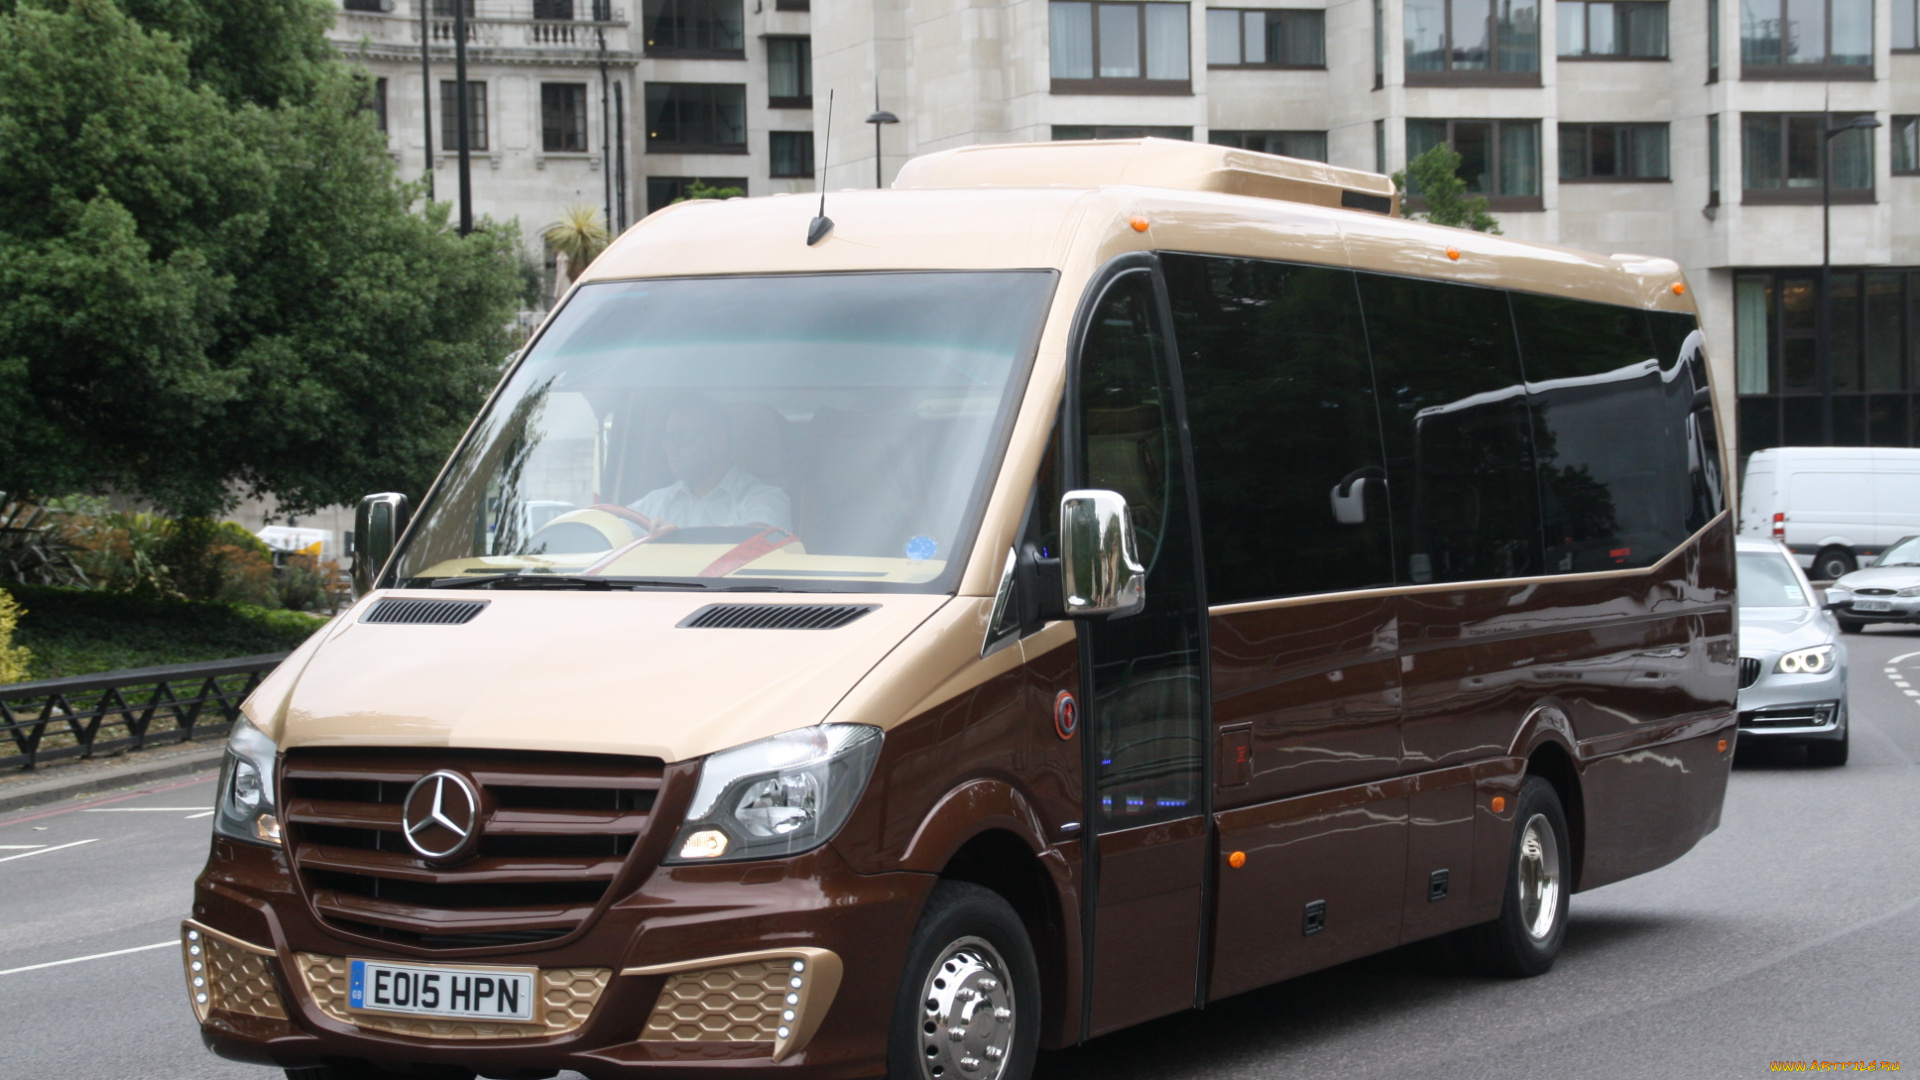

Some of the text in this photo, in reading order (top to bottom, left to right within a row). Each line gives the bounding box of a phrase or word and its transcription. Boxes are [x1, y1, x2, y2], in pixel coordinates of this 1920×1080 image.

[351, 990, 362, 1000] GB
[374, 969, 519, 1013] EO15 HPN
